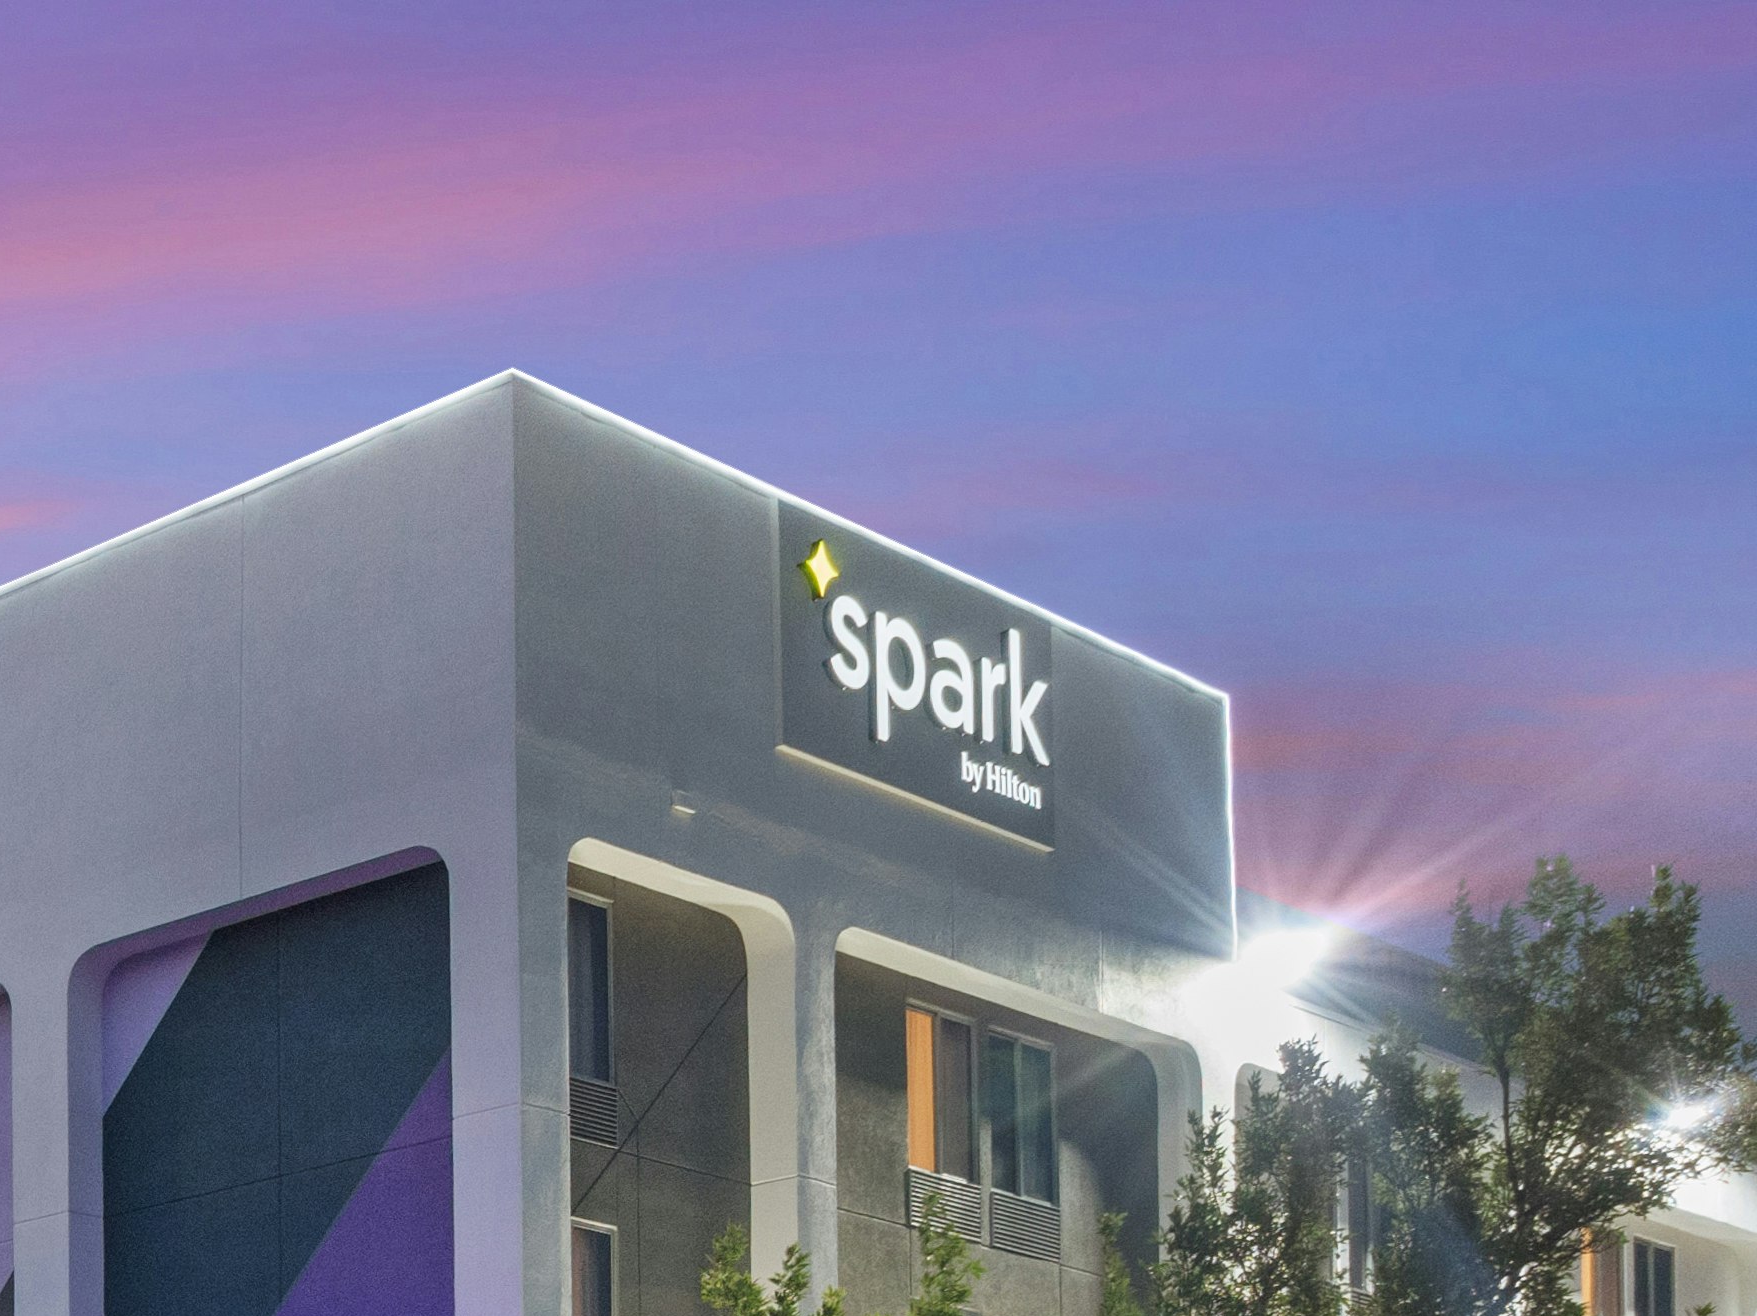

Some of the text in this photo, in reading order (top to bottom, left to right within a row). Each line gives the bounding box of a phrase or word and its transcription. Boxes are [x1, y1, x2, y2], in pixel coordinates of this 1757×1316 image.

[828, 594, 1050, 767] spark
[960, 751, 1042, 811] by Hilton
